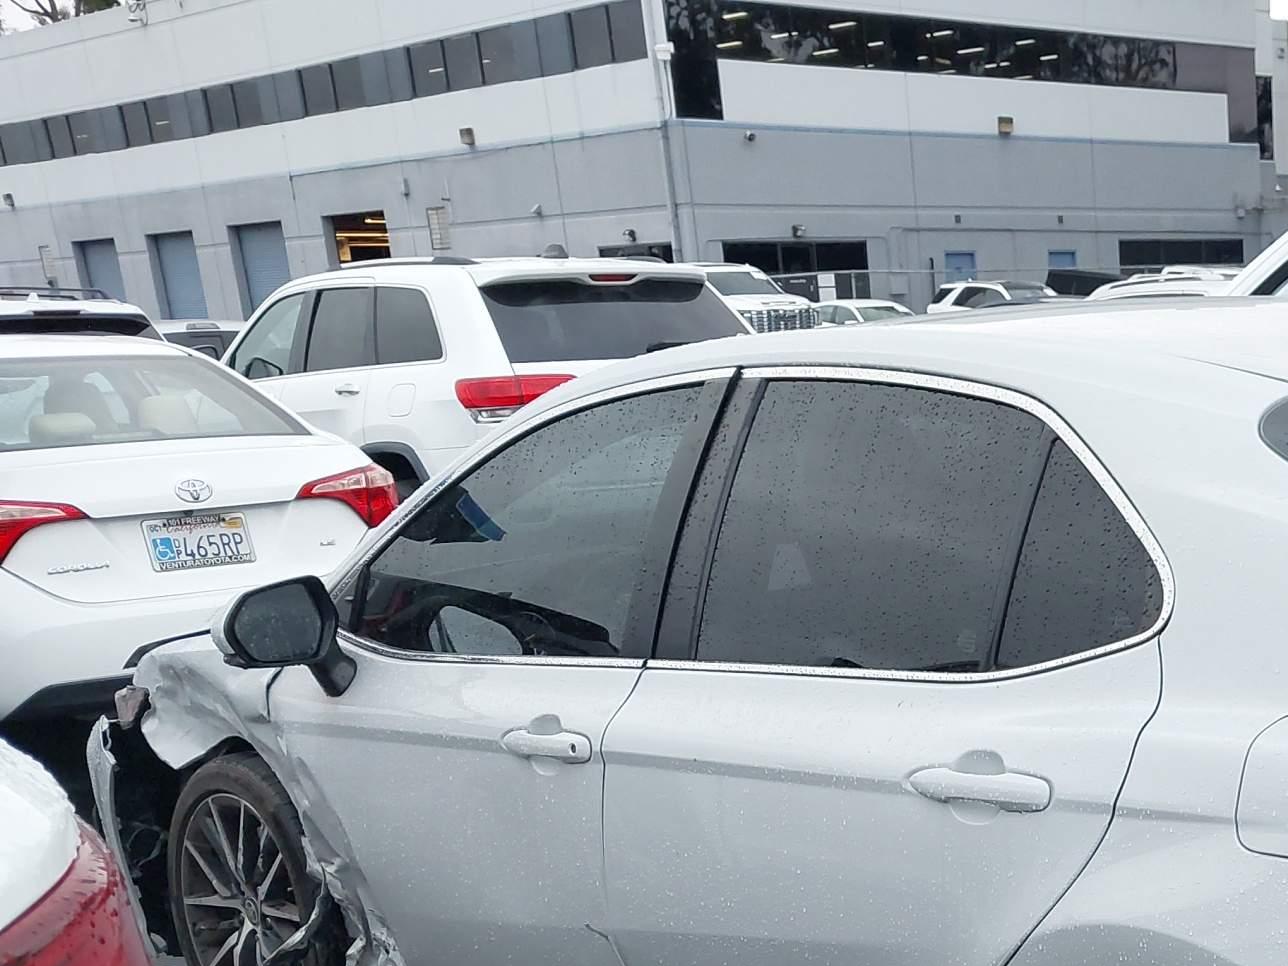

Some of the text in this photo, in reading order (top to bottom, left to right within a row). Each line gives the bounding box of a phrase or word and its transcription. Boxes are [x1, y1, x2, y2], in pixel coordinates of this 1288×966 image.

[181, 514, 220, 525] FREEWAY
[183, 532, 243, 559] 465RP
[160, 554, 251, 570] VENTURATOYOTA.COM
